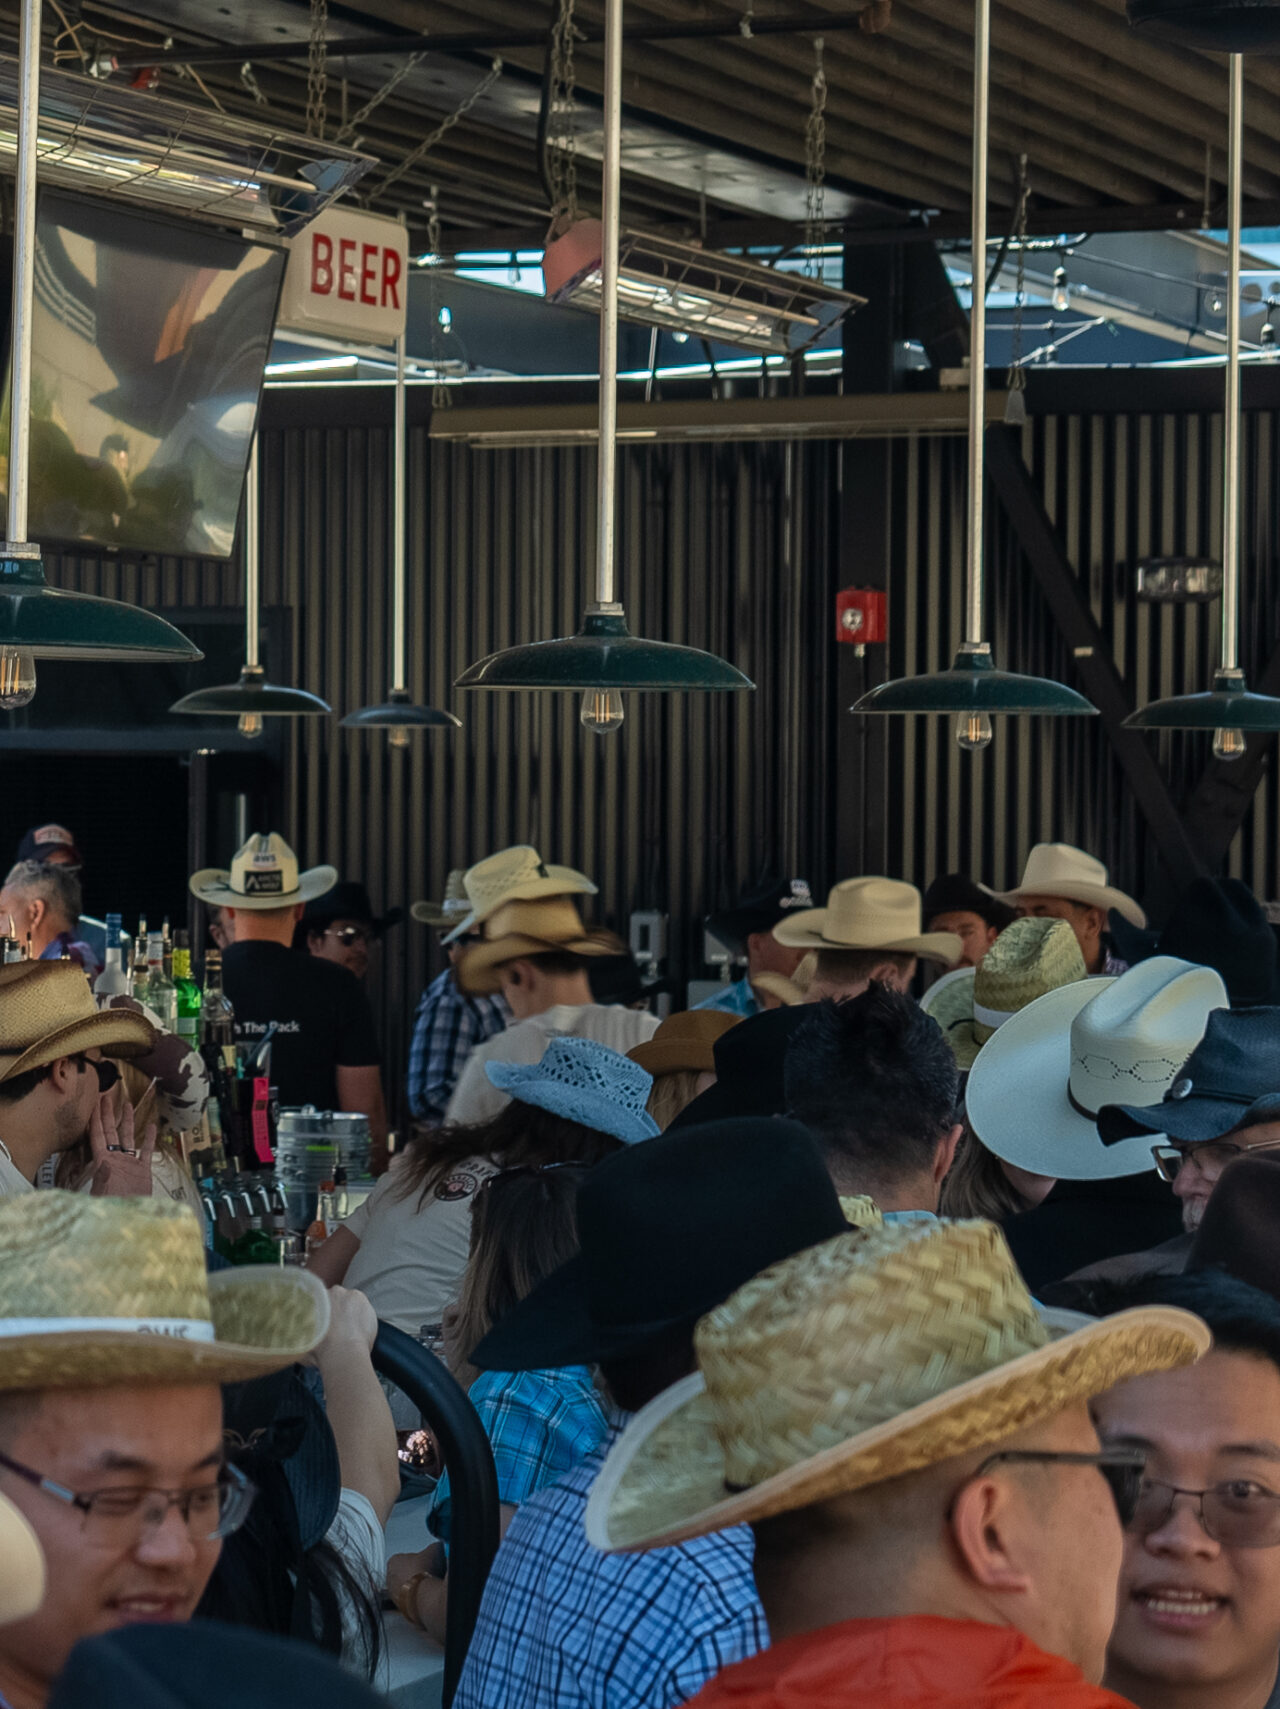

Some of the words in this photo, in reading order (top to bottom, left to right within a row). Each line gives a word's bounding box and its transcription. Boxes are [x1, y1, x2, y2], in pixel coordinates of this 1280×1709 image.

[311, 232, 402, 310] BEER
[243, 1021, 267, 1034] The
[269, 1020, 300, 1033] Pack
